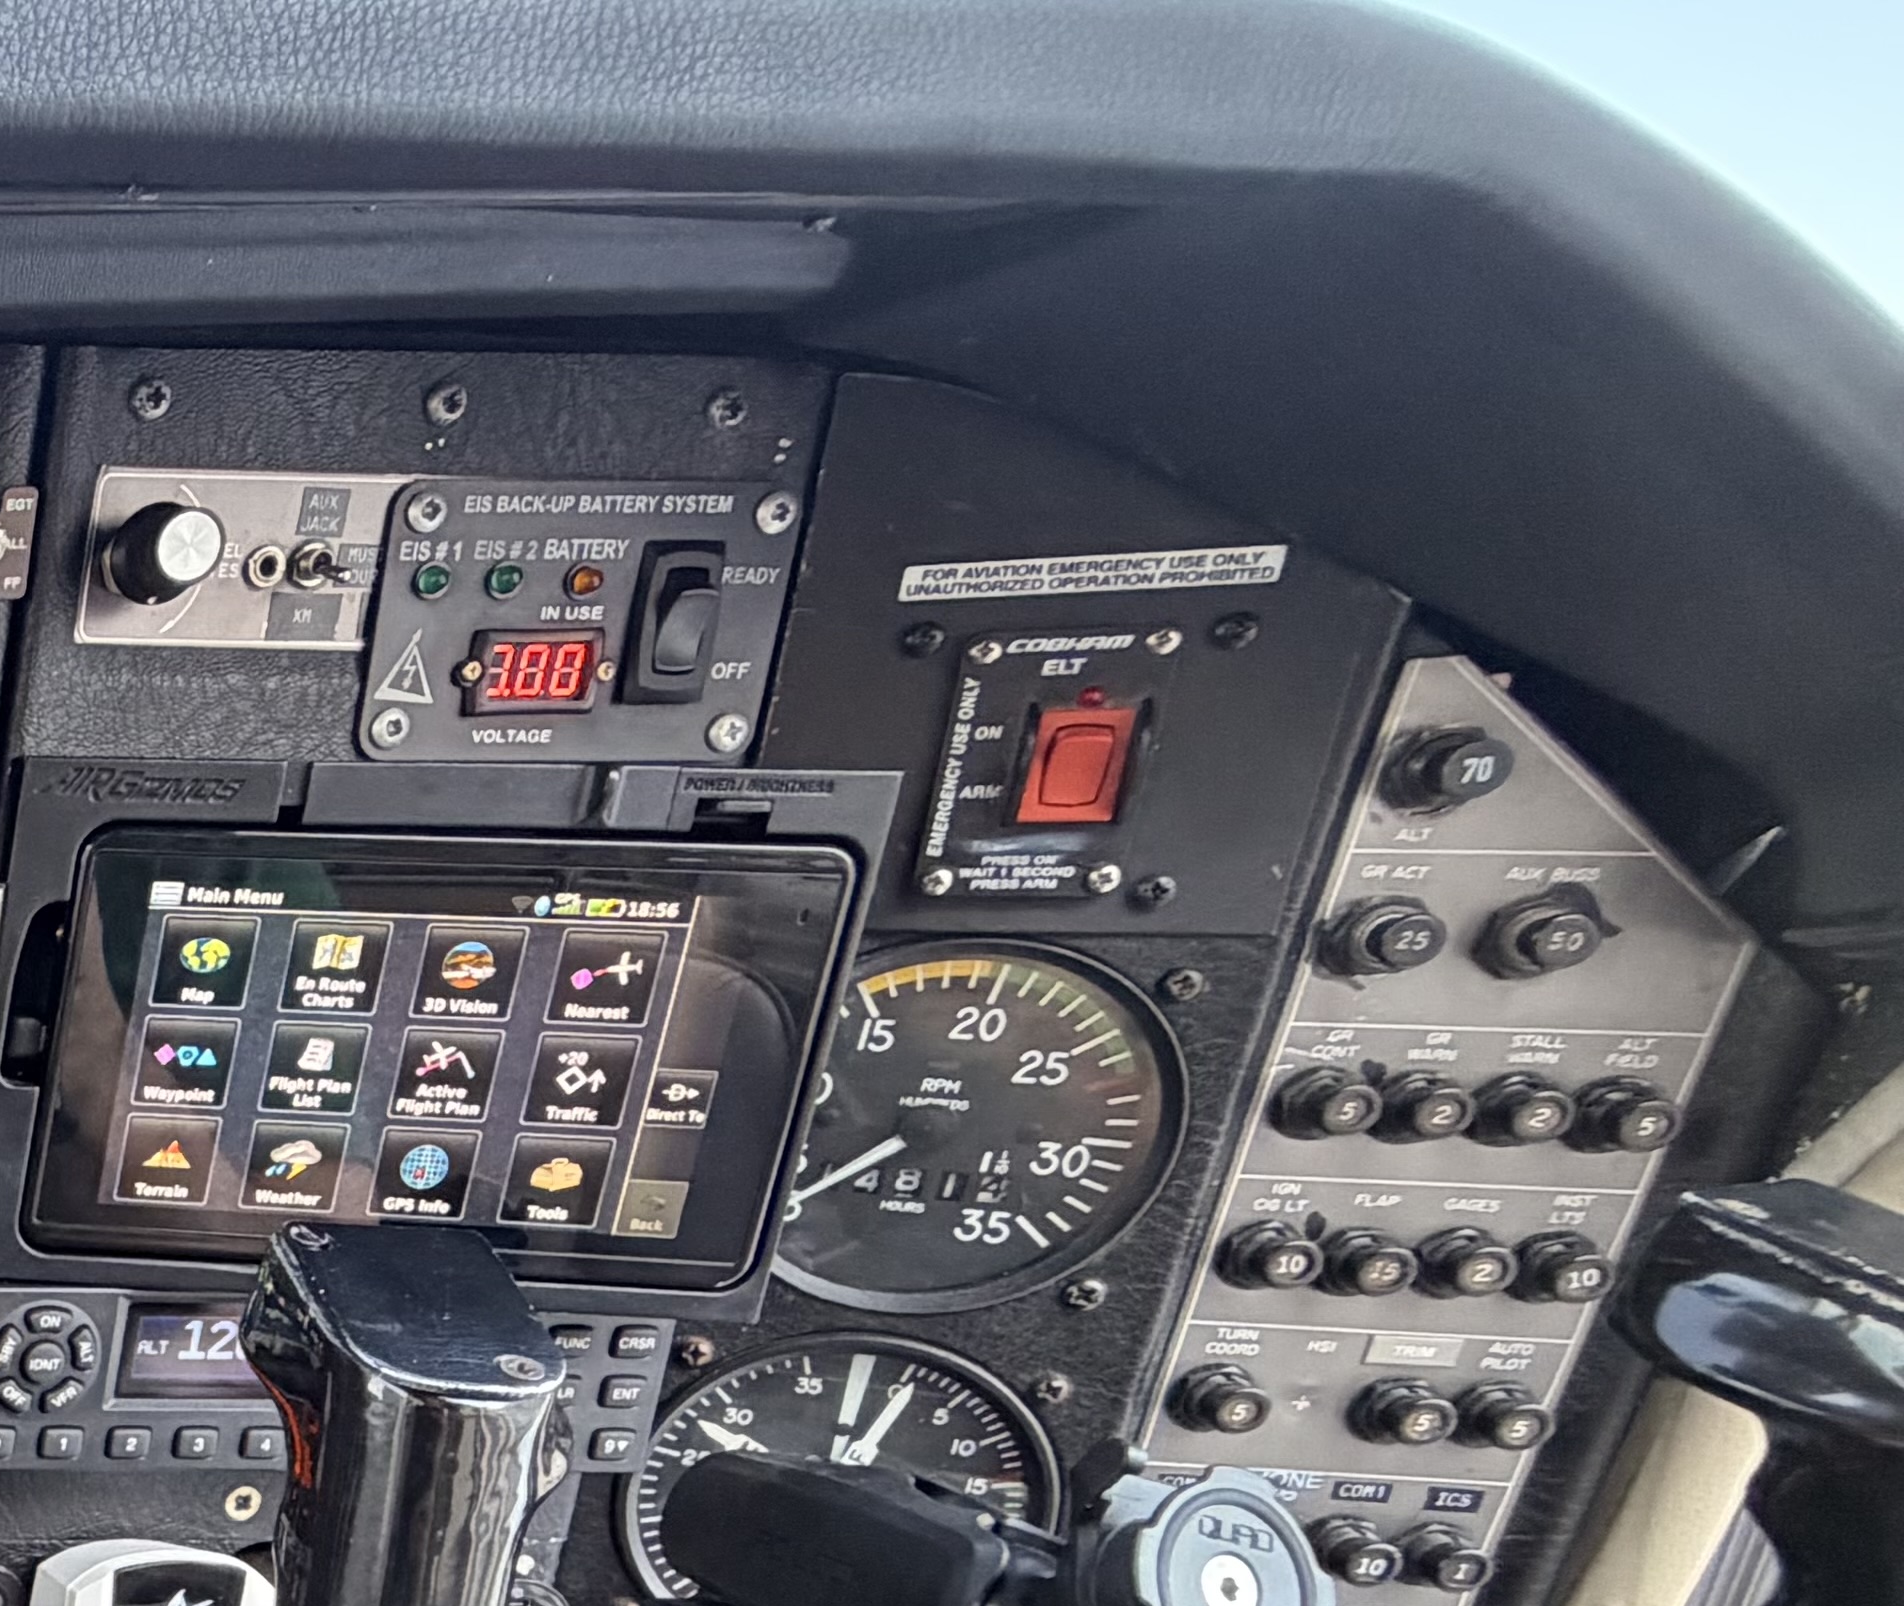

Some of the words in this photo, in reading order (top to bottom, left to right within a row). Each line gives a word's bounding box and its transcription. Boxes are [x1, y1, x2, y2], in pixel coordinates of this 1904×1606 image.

[465, 494, 491, 514] EIS
[496, 494, 576, 514] BACK-UP
[578, 495, 661, 515] BATTERY
[663, 494, 733, 515] SYSTEM
[543, 539, 629, 561] BATTERY
[721, 567, 780, 585] READY
[922, 567, 958, 581] FOR
[962, 564, 1043, 579] AVIATION
[1047, 557, 1163, 575] EMERGENCY
[1168, 555, 1207, 569] USE
[1212, 551, 1265, 566] ONLY
[906, 578, 1043, 597] UNAUTHORIZED
[1048, 572, 1154, 589] OPERATION
[1158, 566, 1275, 584] PROHIBITED
[540, 605, 560, 621] IN
[564, 605, 604, 621] USE
[1007, 634, 1135, 654] COBHAM
[711, 661, 751, 680] OFF
[1041, 658, 1087, 676] ELT
[471, 729, 552, 744] VOLTAGE
[975, 725, 1003, 740] ON
[1460, 755, 1494, 784] 70
[187, 885, 230, 906] Main
[234, 887, 284, 907] Menu
[626, 899, 680, 919] 18:56
[448, 997, 498, 1017] Vision
[564, 1002, 629, 1020] Nearest
[948, 1007, 1007, 1042] 20
[1011, 1050, 1070, 1086] 25
[1434, 1491, 1472, 1508] ICS
